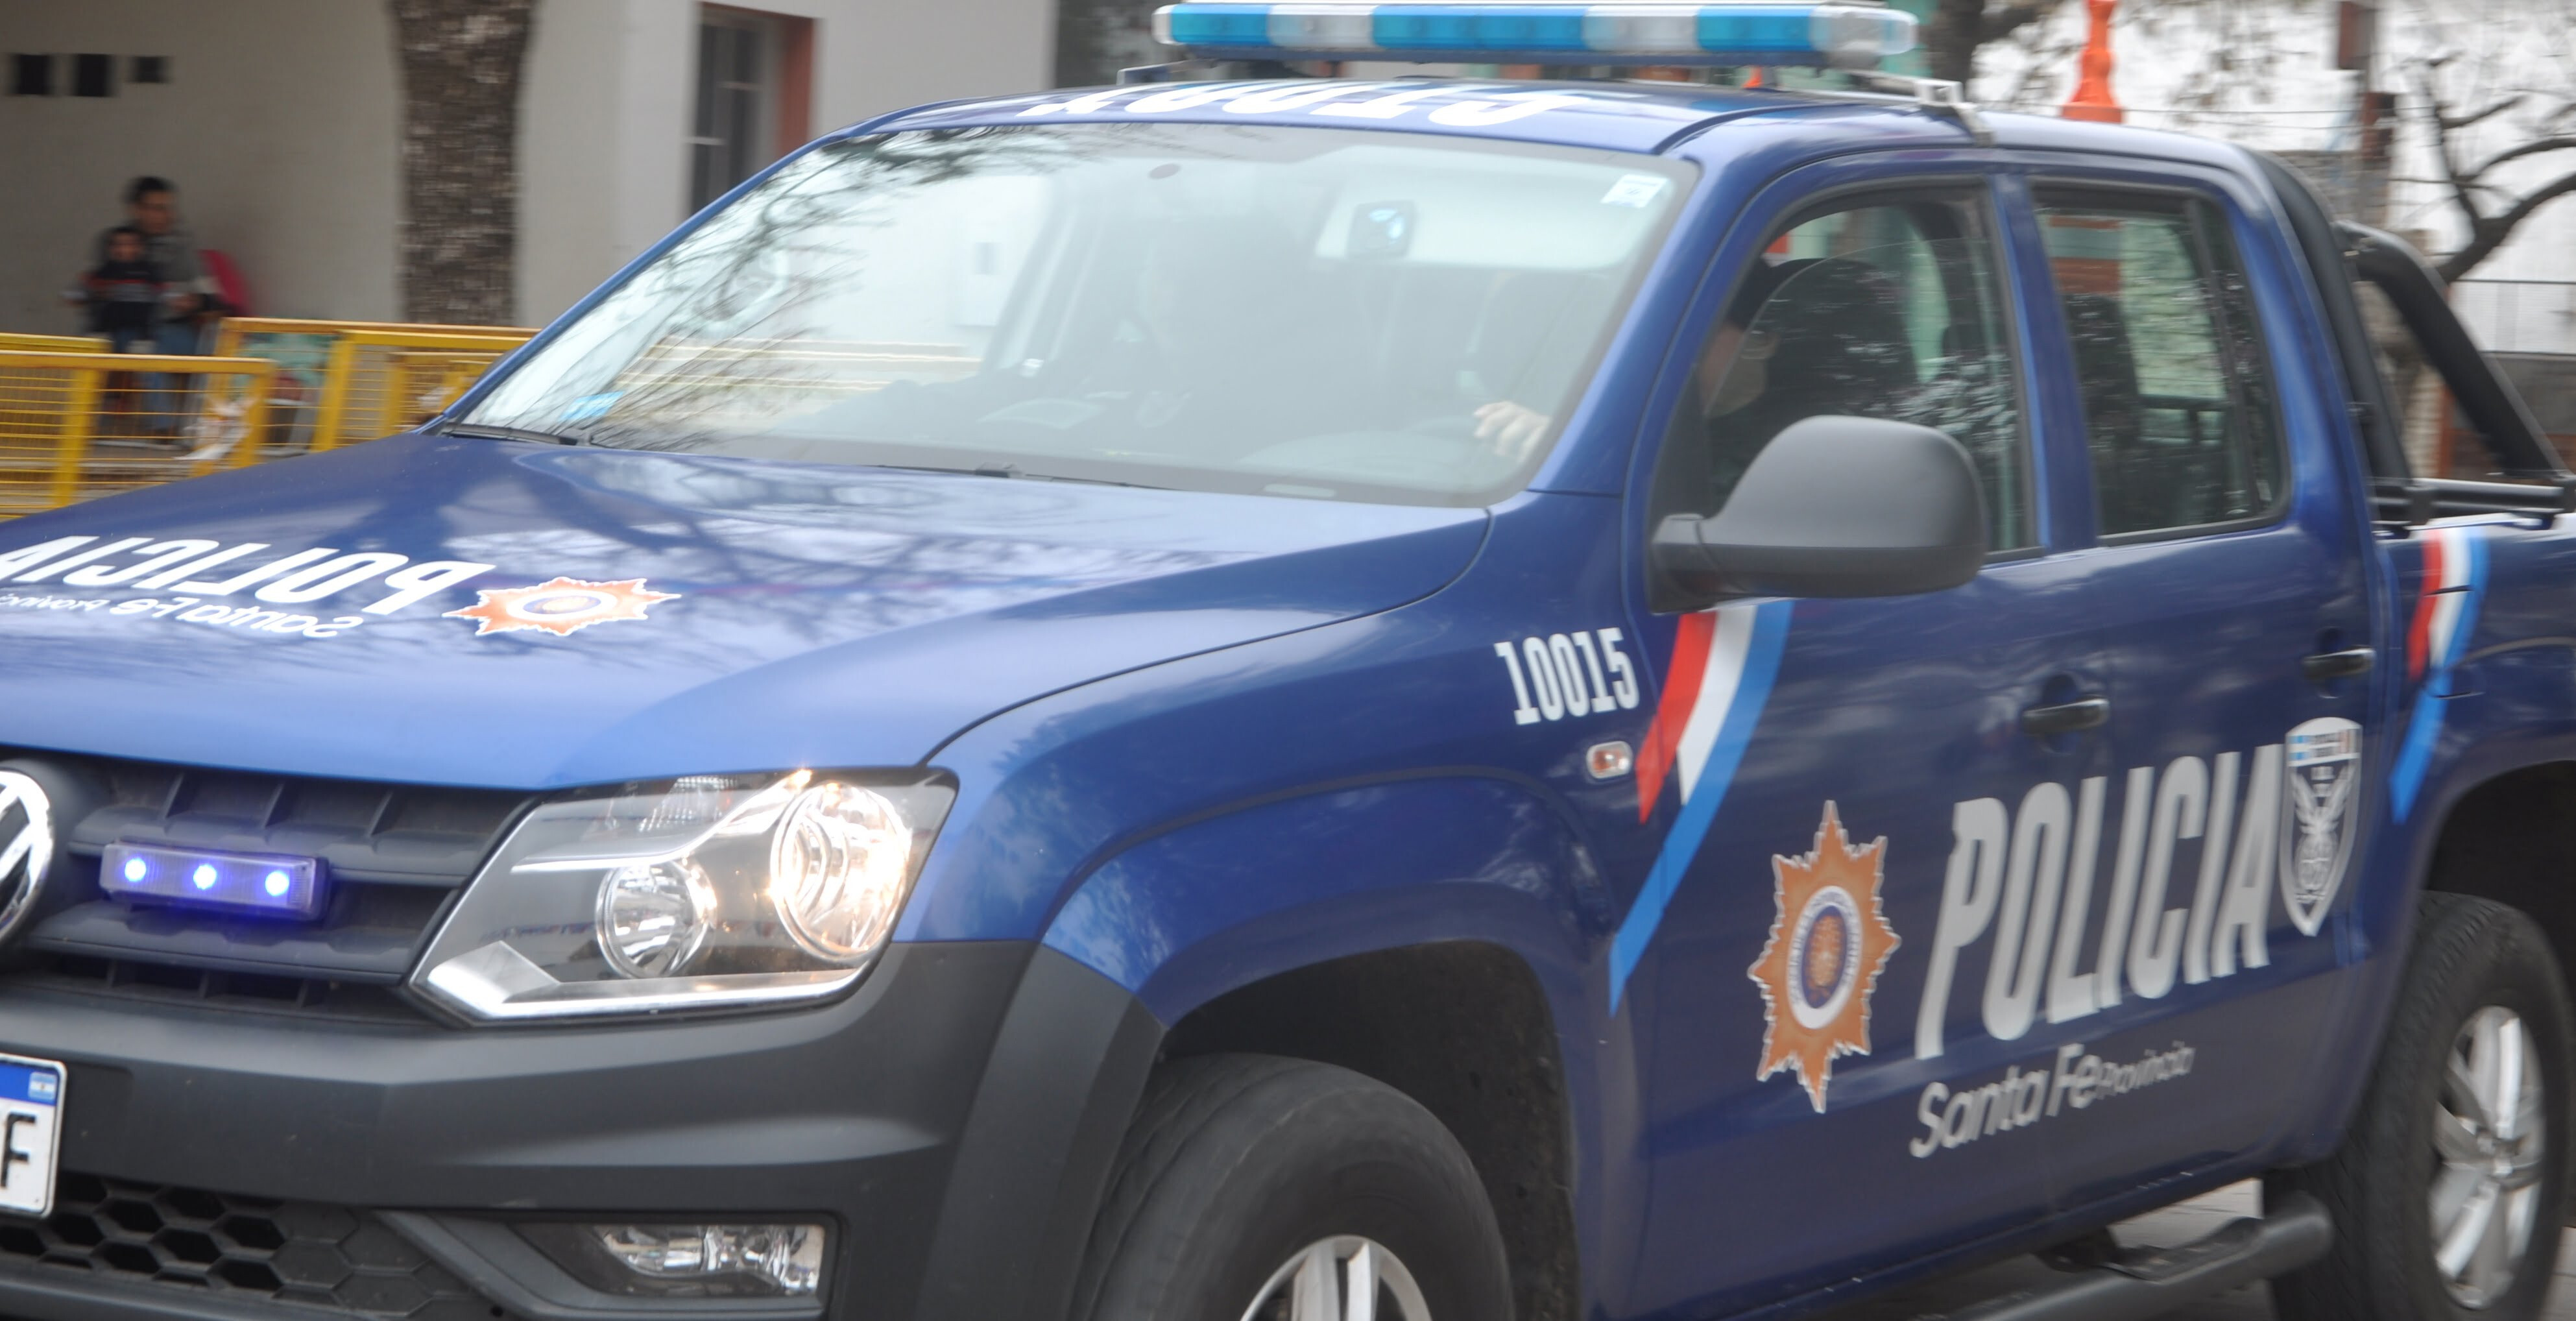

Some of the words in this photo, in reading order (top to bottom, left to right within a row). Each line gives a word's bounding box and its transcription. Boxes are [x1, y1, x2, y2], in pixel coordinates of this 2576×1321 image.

[1493, 627, 1639, 725] 10015
[1915, 744, 2283, 1060] POLICIA
[1909, 1065, 2049, 1159] Santa
[2045, 1043, 2102, 1117] Fe
